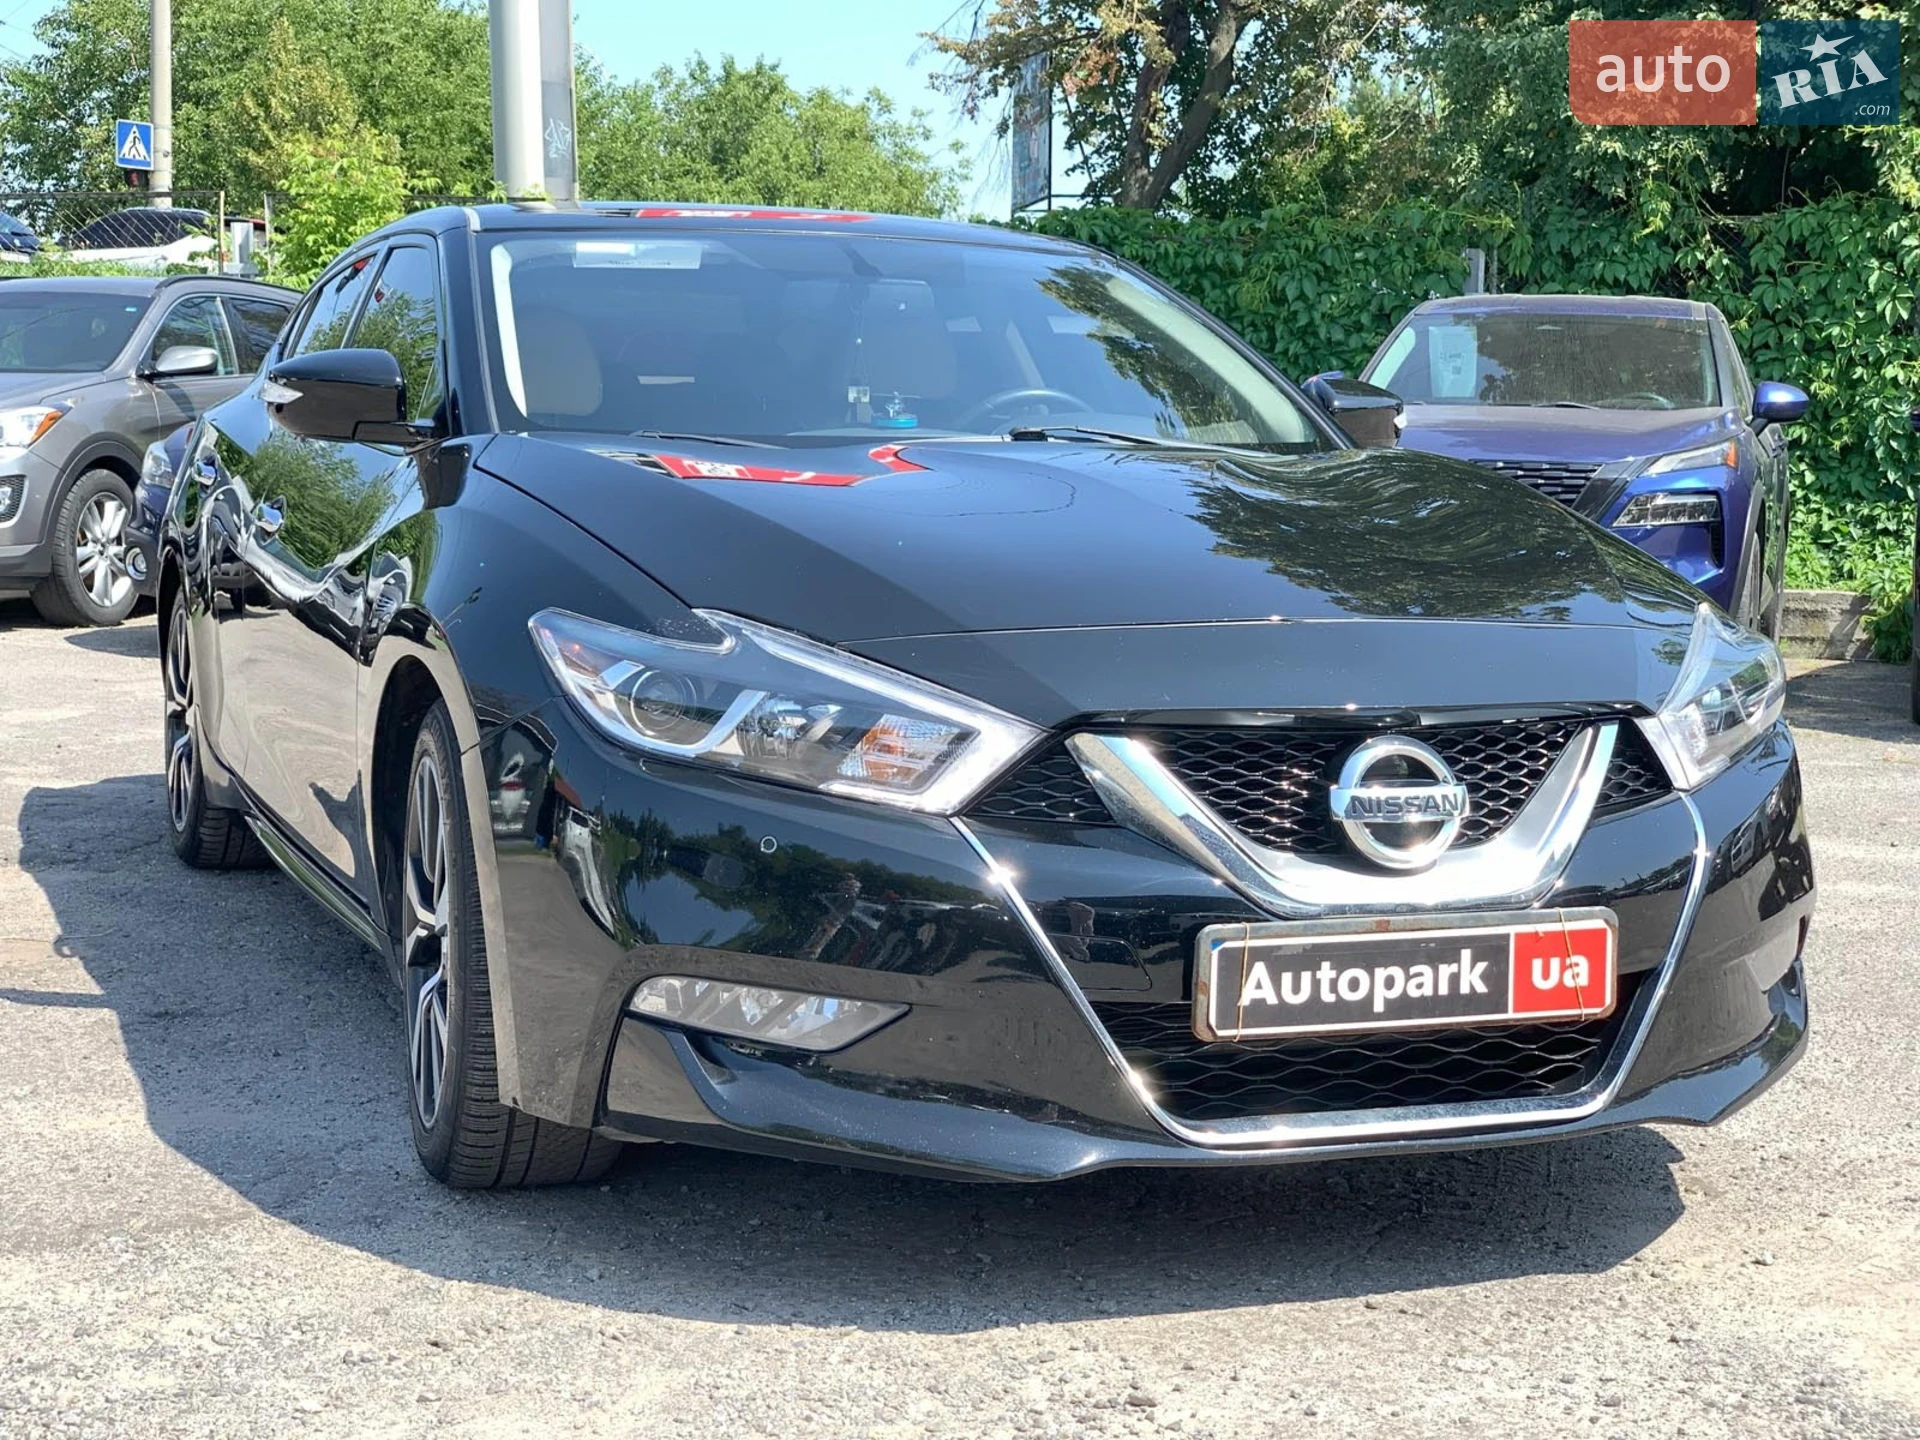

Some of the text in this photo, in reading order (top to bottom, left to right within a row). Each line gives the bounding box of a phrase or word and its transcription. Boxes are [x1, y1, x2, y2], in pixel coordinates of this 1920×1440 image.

[1349, 793, 1460, 815] NISSAN
[1240, 948, 1590, 1013] Autopark ua
